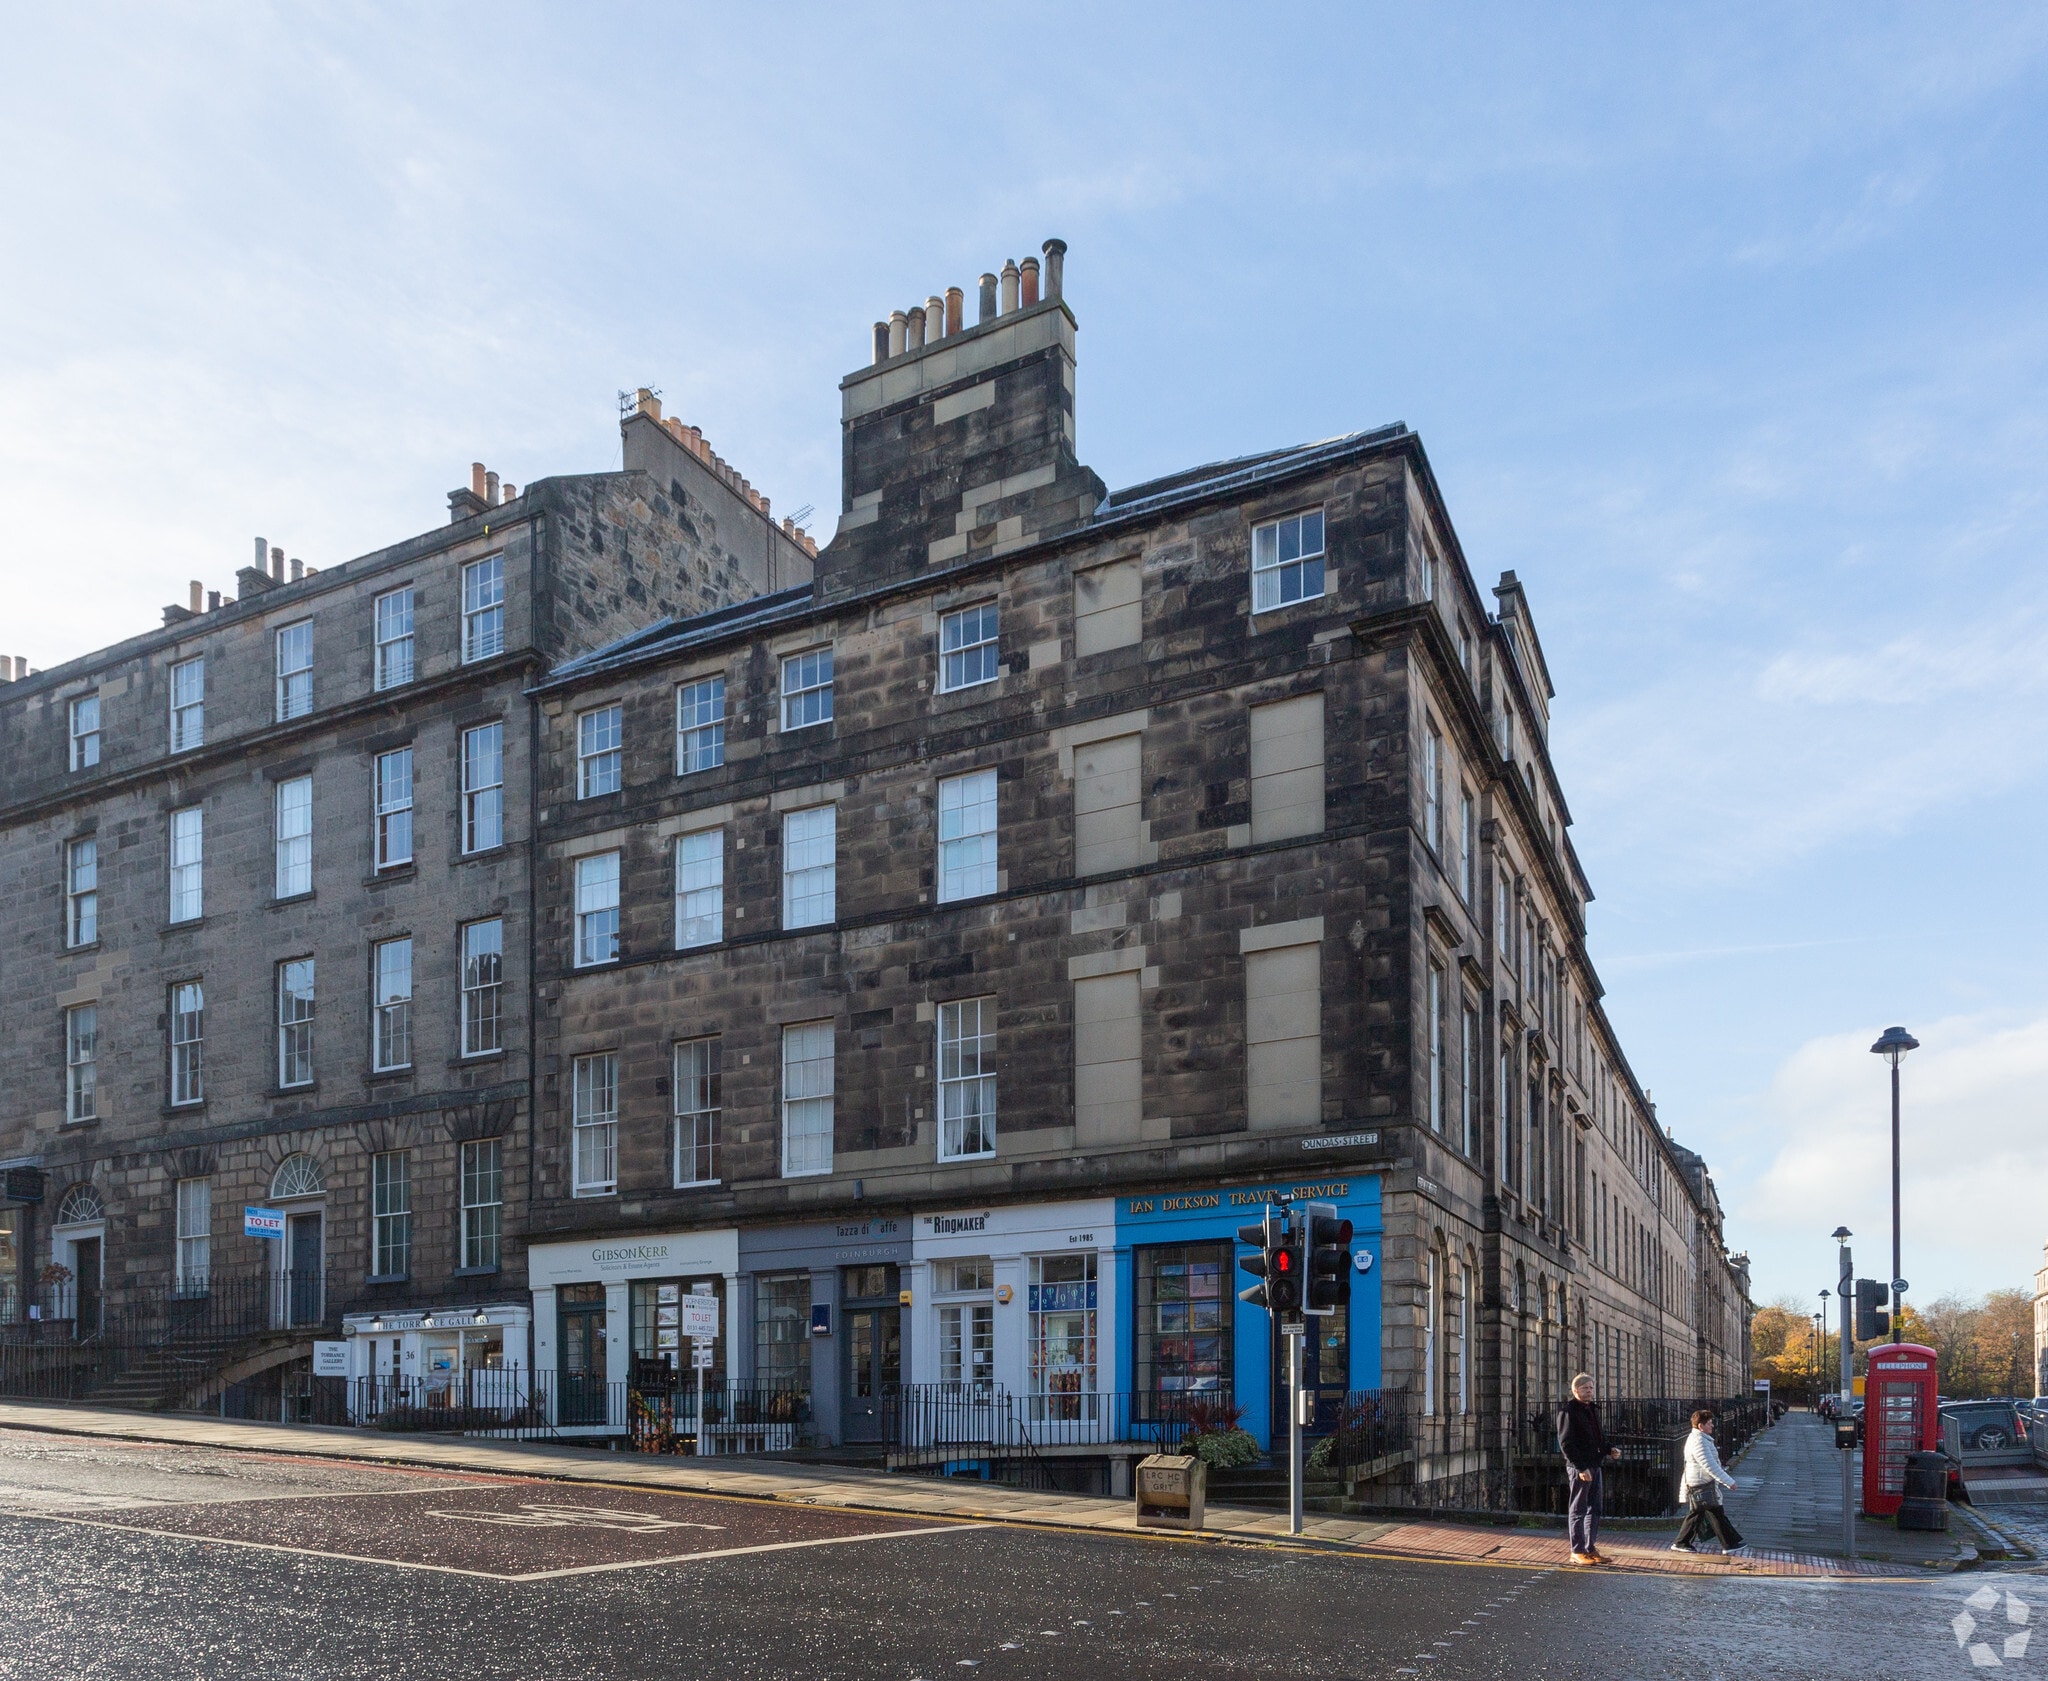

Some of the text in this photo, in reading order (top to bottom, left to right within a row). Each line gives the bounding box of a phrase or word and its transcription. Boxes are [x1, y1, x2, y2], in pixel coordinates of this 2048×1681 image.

[1303, 1134, 1376, 1149] DUNDAS STREET
[1130, 1183, 1348, 1213] IAN DICKSON TRAVE SERVICE
[249, 1217, 280, 1228] TO LET
[923, 1216, 933, 1225] THE
[836, 1225, 859, 1237] Tazza
[861, 1223, 869, 1235] di
[1069, 1234, 1094, 1243] Est 1985
[592, 1245, 669, 1262] GIBSONKERR
[835, 1247, 898, 1259] EDINBURGH
[398, 1318, 444, 1329] TORRANCE
[448, 1315, 490, 1327] GALLERY
[691, 1312, 711, 1323] TO LET
[405, 1351, 415, 1360] 36
[1880, 1362, 1925, 1370] TELEPHONE
[1146, 1471, 1163, 1480] LRC
[1152, 1483, 1173, 1491] GRIT
